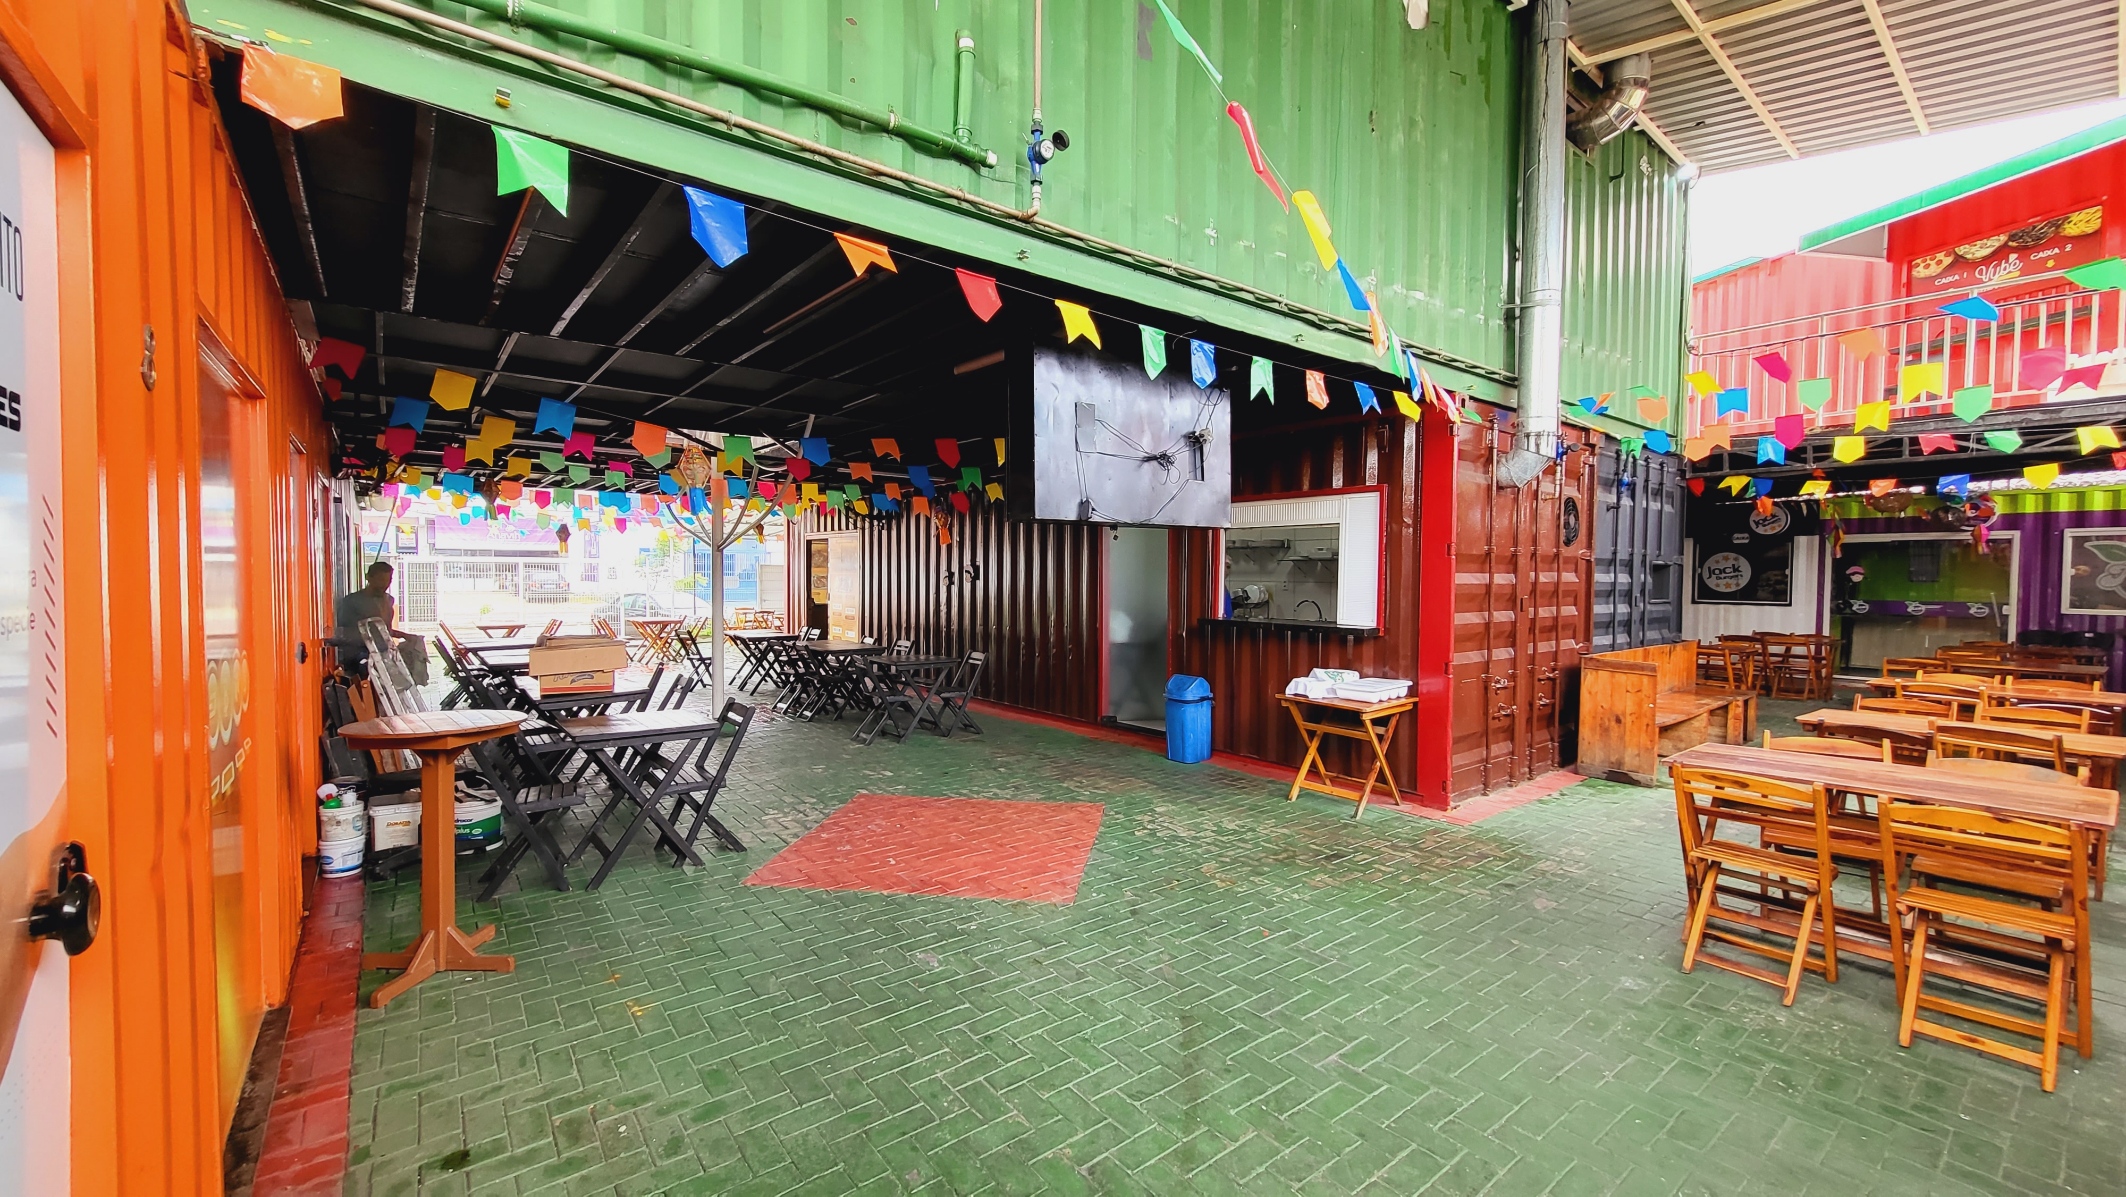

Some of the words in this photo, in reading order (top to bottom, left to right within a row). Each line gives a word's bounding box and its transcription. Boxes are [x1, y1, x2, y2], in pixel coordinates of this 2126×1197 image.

[2030, 247, 2060, 260] CAIXA
[2064, 244, 2072, 252] 2
[1707, 564, 1743, 580] Jack
